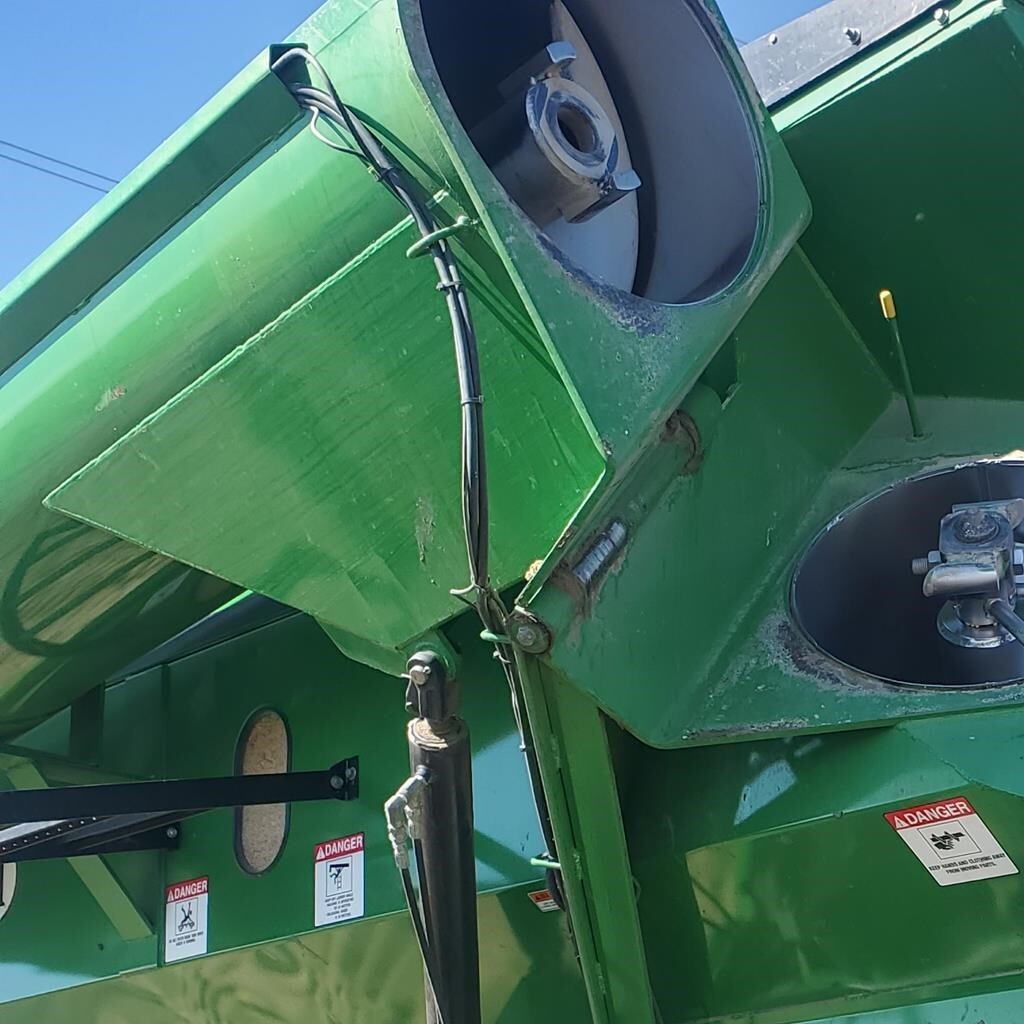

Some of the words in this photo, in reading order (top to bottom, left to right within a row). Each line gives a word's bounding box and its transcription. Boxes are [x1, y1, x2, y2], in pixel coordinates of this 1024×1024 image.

[904, 801, 972, 825] DANGER
[325, 835, 363, 856] DANGER
[174, 880, 207, 900] DANGER
